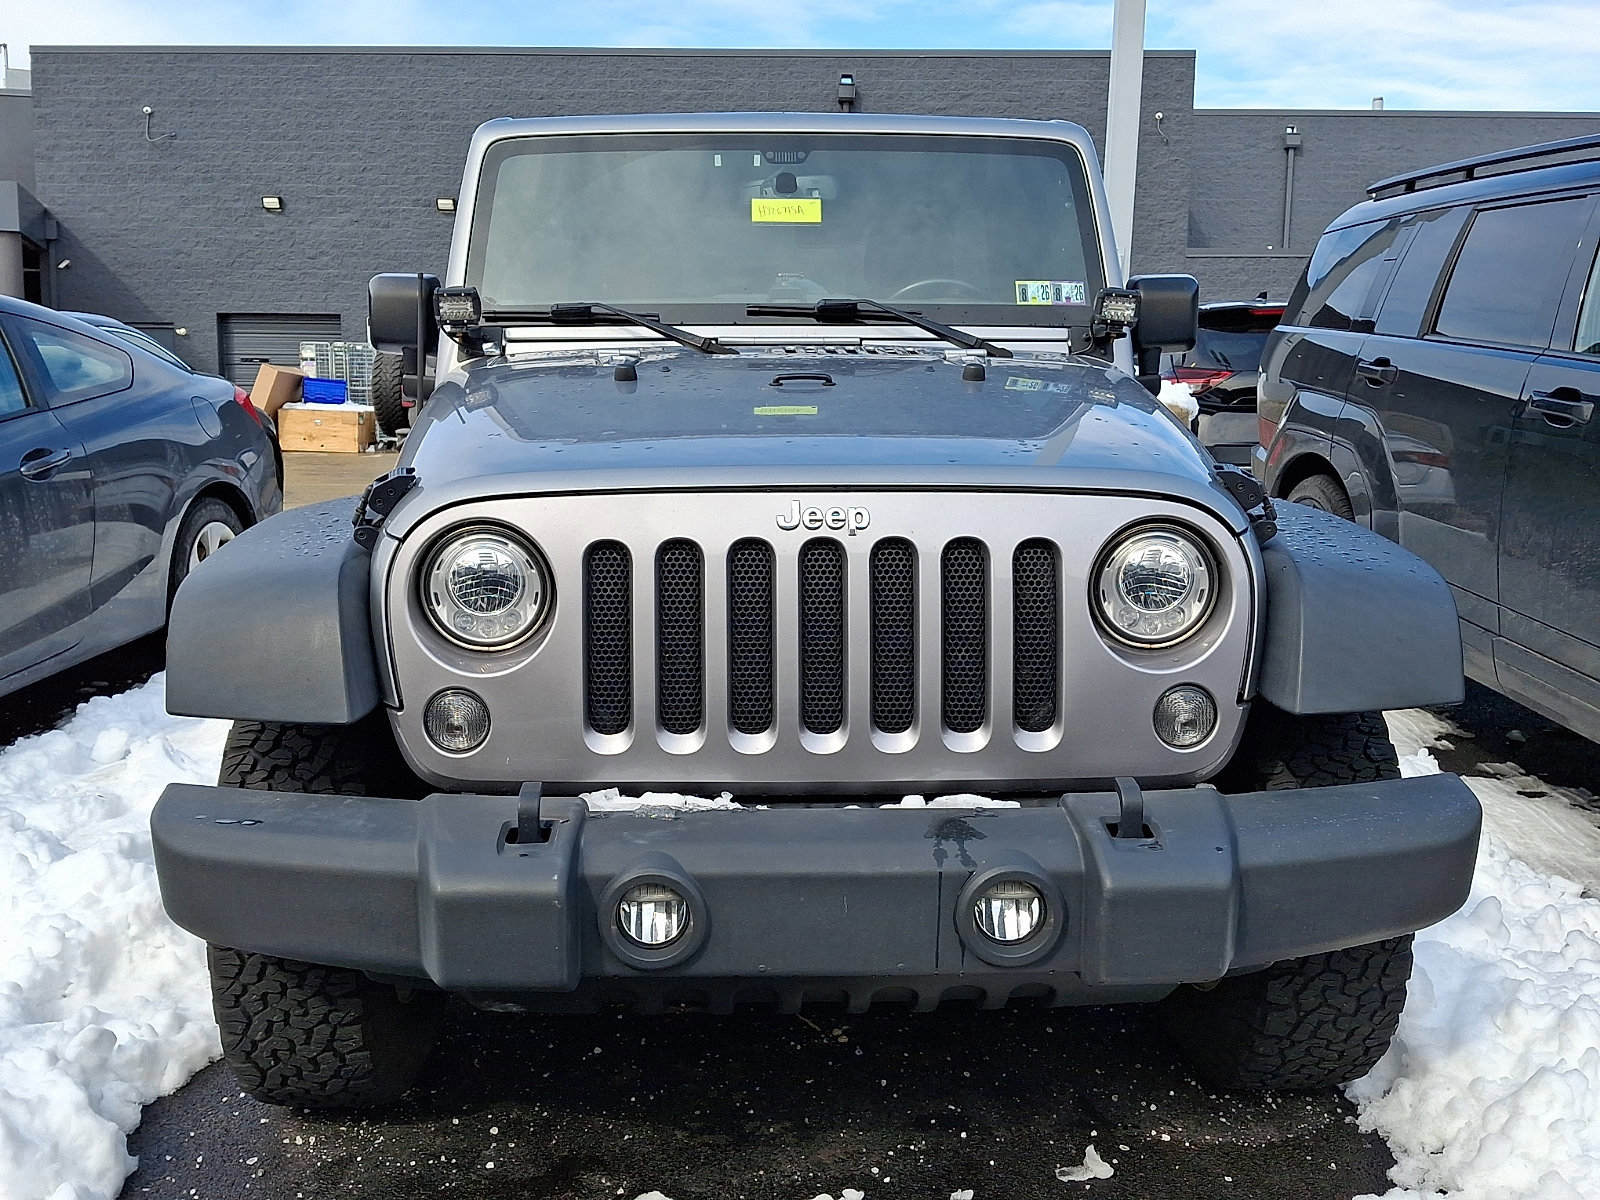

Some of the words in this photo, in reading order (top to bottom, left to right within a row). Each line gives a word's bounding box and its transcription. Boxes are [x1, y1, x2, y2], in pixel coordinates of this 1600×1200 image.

[1021, 287, 1027, 302] 8
[1040, 284, 1050, 300] 26
[1055, 287, 1061, 301] 8
[1074, 284, 1084, 301] 26
[776, 499, 871, 536] Jeep
